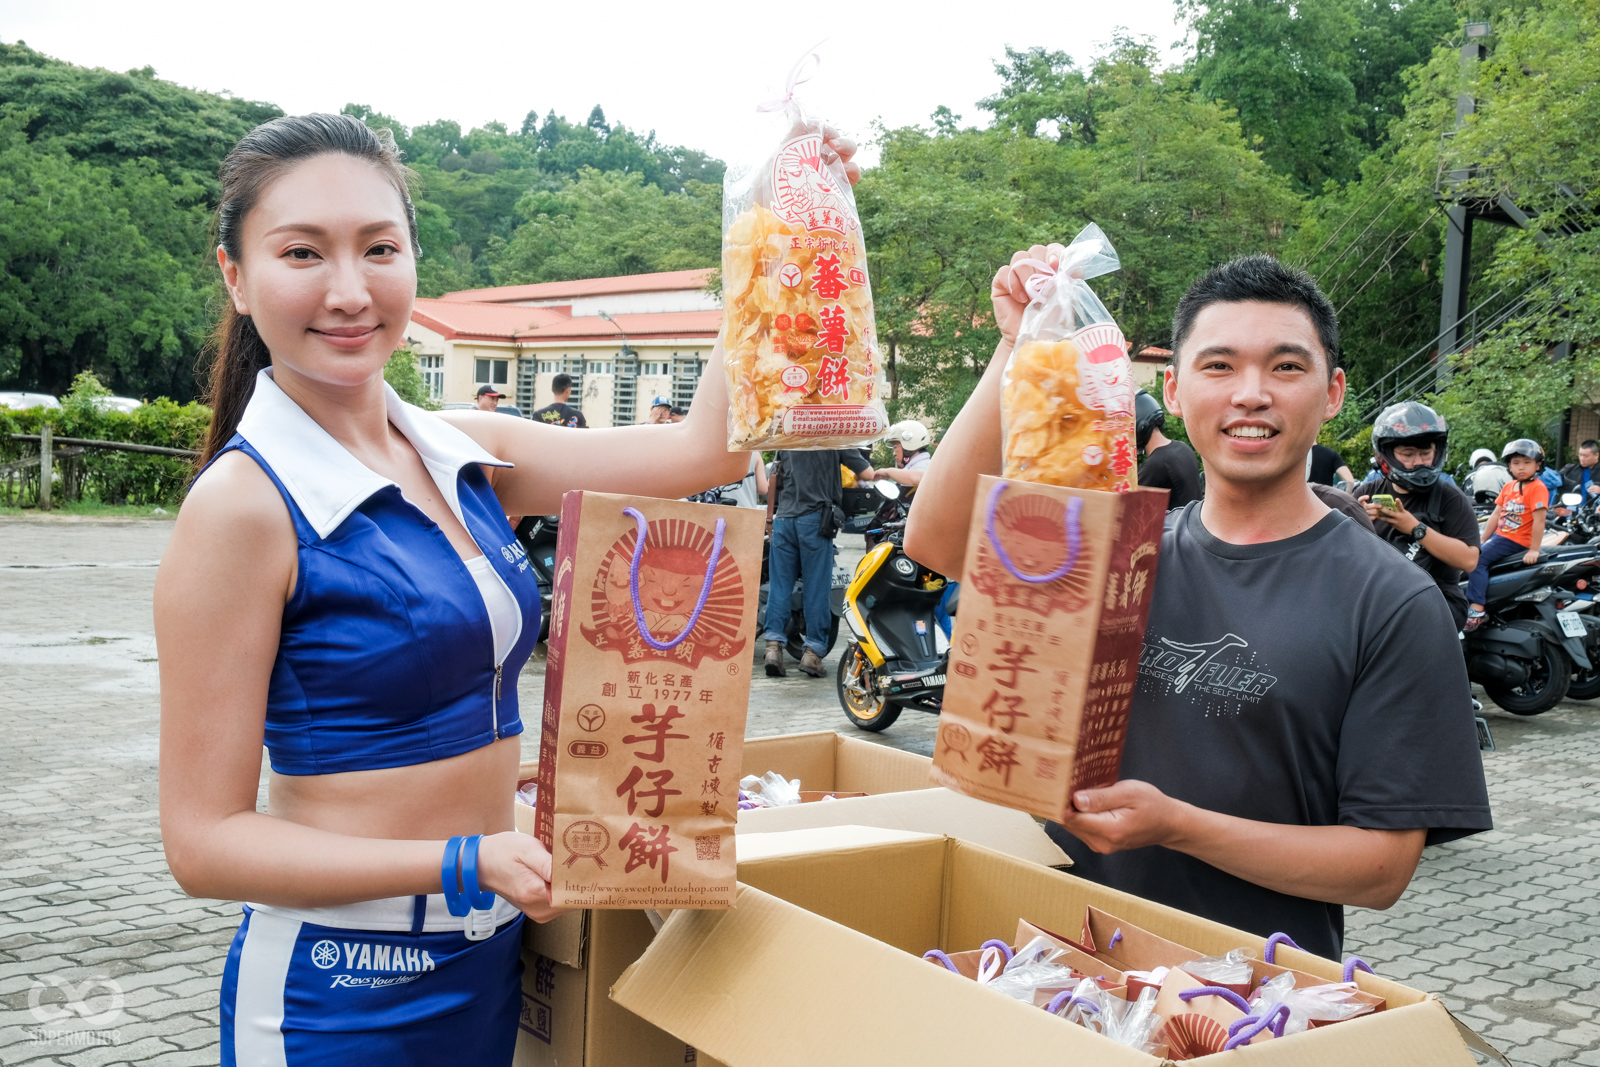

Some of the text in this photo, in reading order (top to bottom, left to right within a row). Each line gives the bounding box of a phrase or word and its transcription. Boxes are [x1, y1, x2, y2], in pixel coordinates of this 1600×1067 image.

[811, 252, 851, 401] 蕃薯餅
[595, 633, 608, 647] 正
[719, 642, 732, 656] 宗
[627, 670, 693, 688] 新化名產
[921, 673, 947, 688] YAMAHA
[1194, 661, 1278, 697] FLIER
[1193, 683, 1211, 694] THE
[1212, 689, 1262, 705] SELF-LIMIT
[976, 639, 1041, 788] 芋仔餅
[700, 731, 726, 816] 循古煉製
[616, 703, 690, 885] 芋仔餅
[565, 880, 729, 893] http://www.sweetpotatoshop.com
[564, 895, 729, 906] e-mail:sale@sweetpotatoshop.com
[343, 942, 436, 972] YAMAHA
[330, 974, 373, 988] Revs
